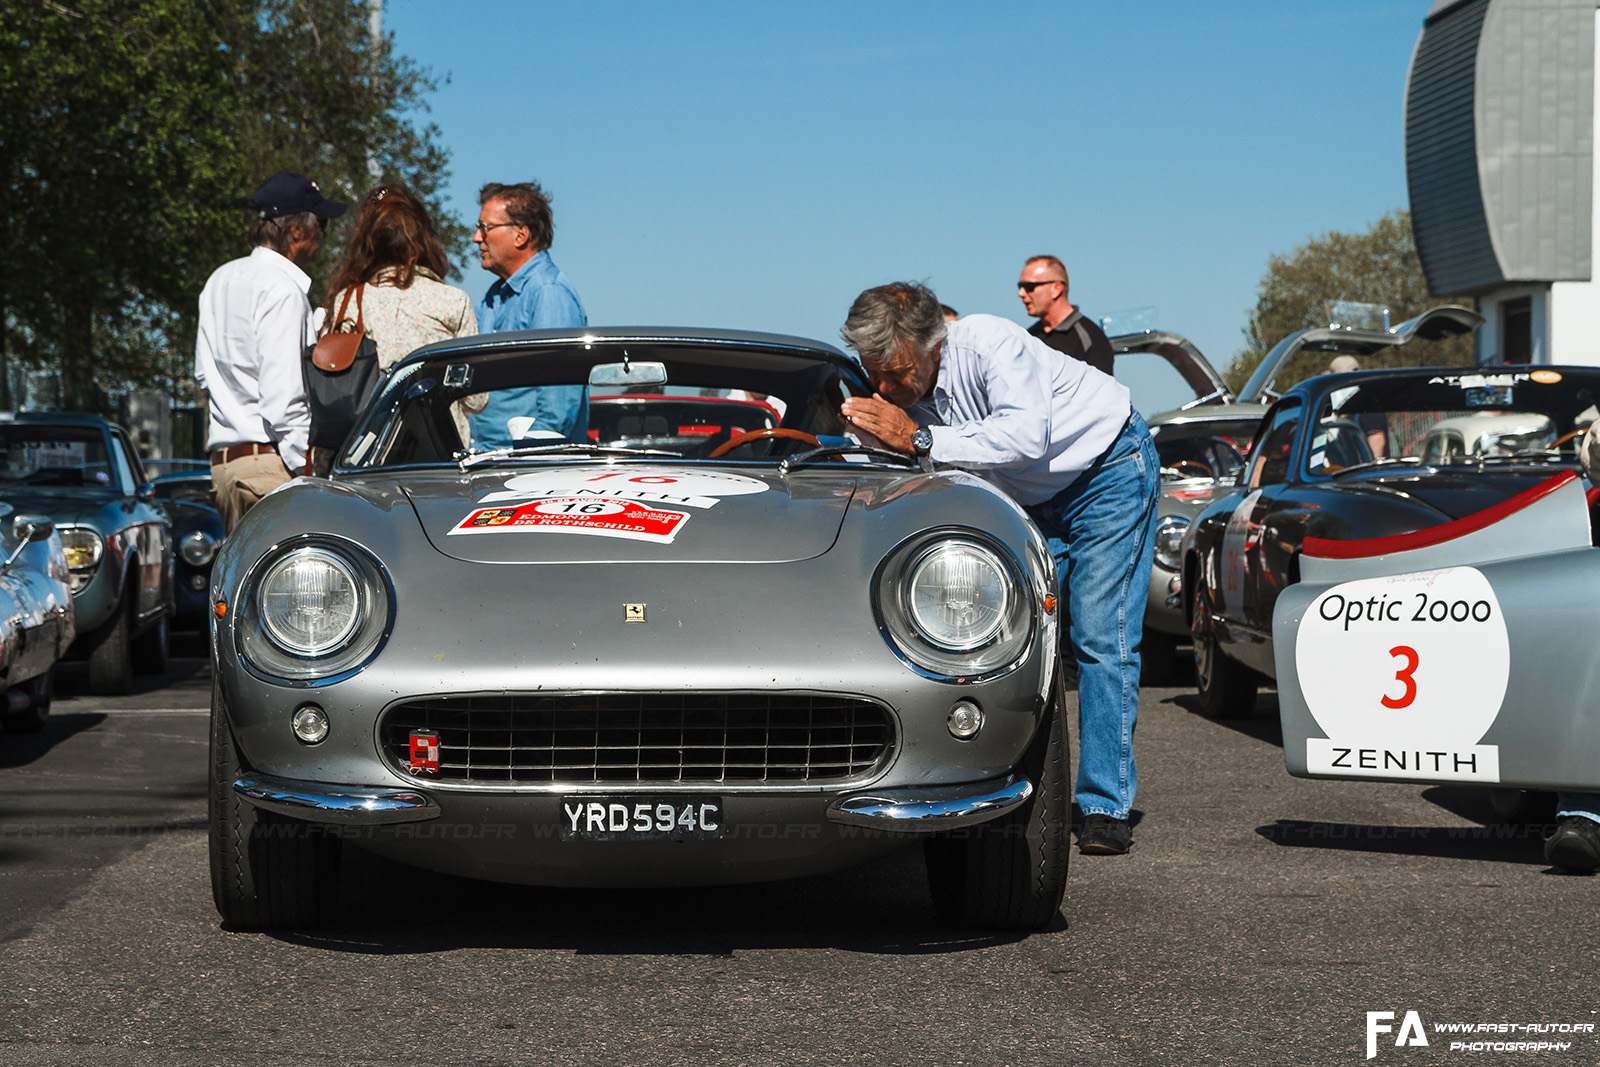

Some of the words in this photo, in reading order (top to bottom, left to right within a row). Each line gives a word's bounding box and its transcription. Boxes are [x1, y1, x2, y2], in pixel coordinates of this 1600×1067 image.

[586, 472, 685, 484] 16
[511, 488, 691, 503] ZENITH
[561, 503, 606, 514] 16
[517, 513, 591, 521] EDMOND
[539, 519, 646, 532] ROTHSCHILD
[1319, 593, 1403, 631] Optic
[1411, 593, 1491, 622] 2000
[1380, 645, 1420, 709] 3
[1331, 747, 1477, 773] ZENITH
[563, 802, 720, 832] YRD594C
